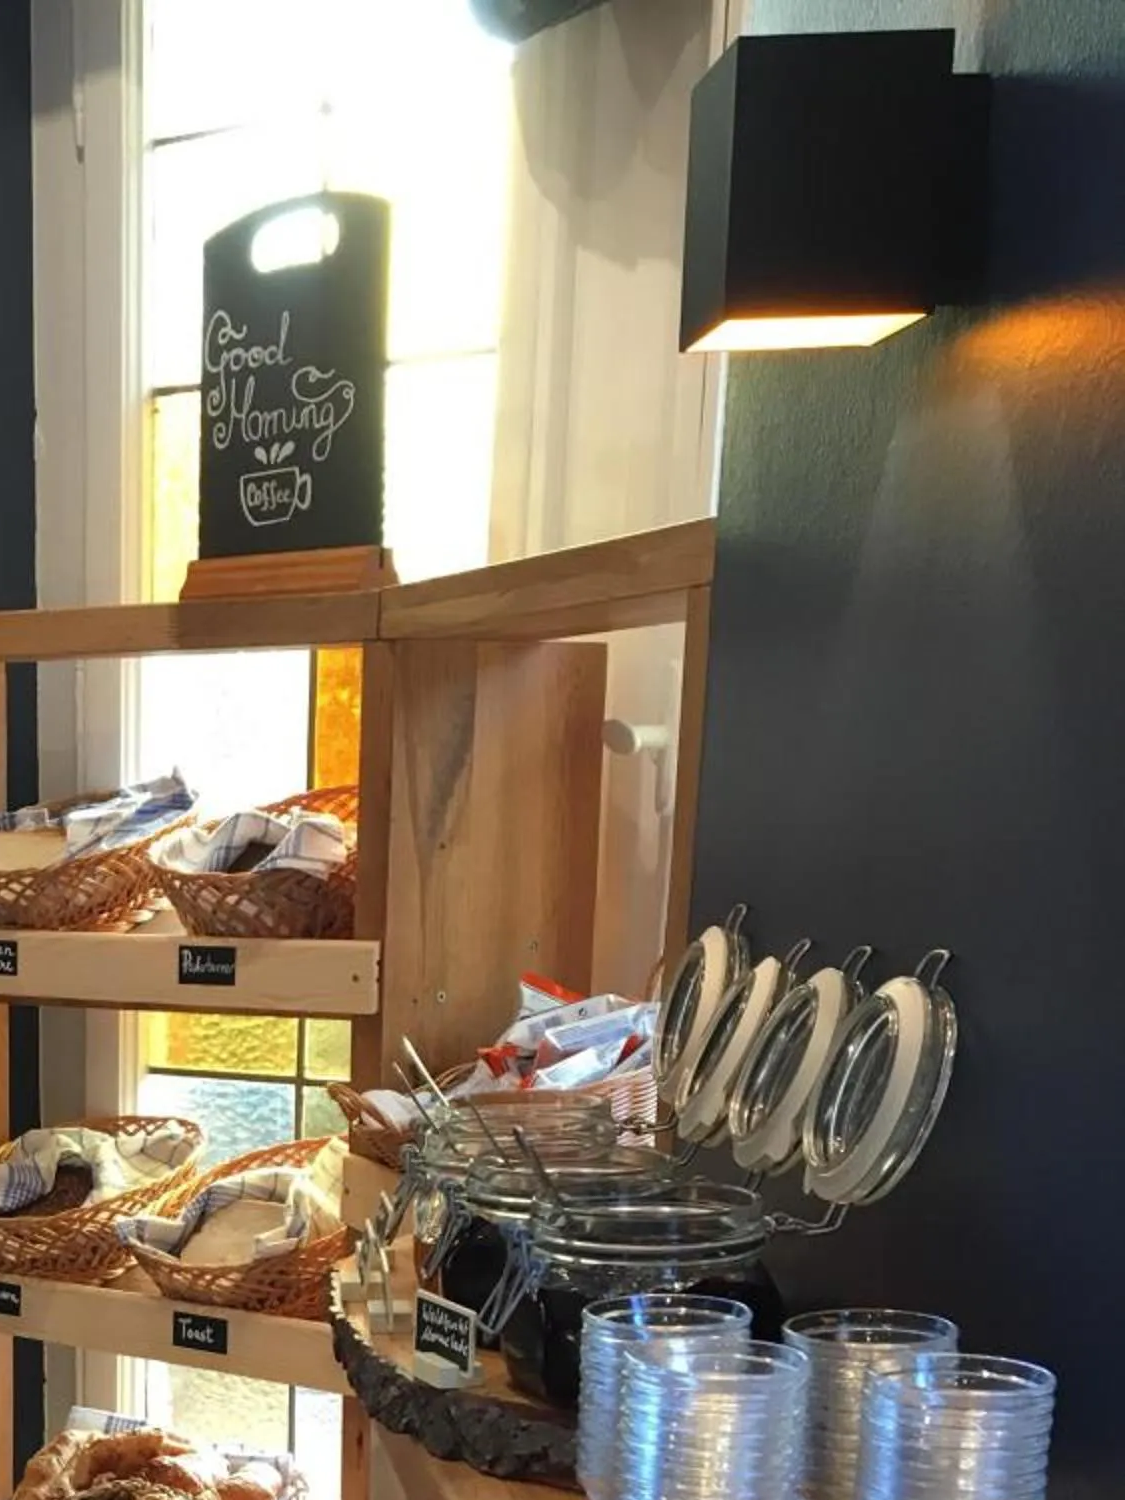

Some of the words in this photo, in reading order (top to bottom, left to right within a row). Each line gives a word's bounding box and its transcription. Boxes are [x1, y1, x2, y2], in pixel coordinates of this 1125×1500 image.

[204, 310, 293, 416] Good
[247, 480, 291, 511] Coffee
[178, 1317, 215, 1344] Toast
